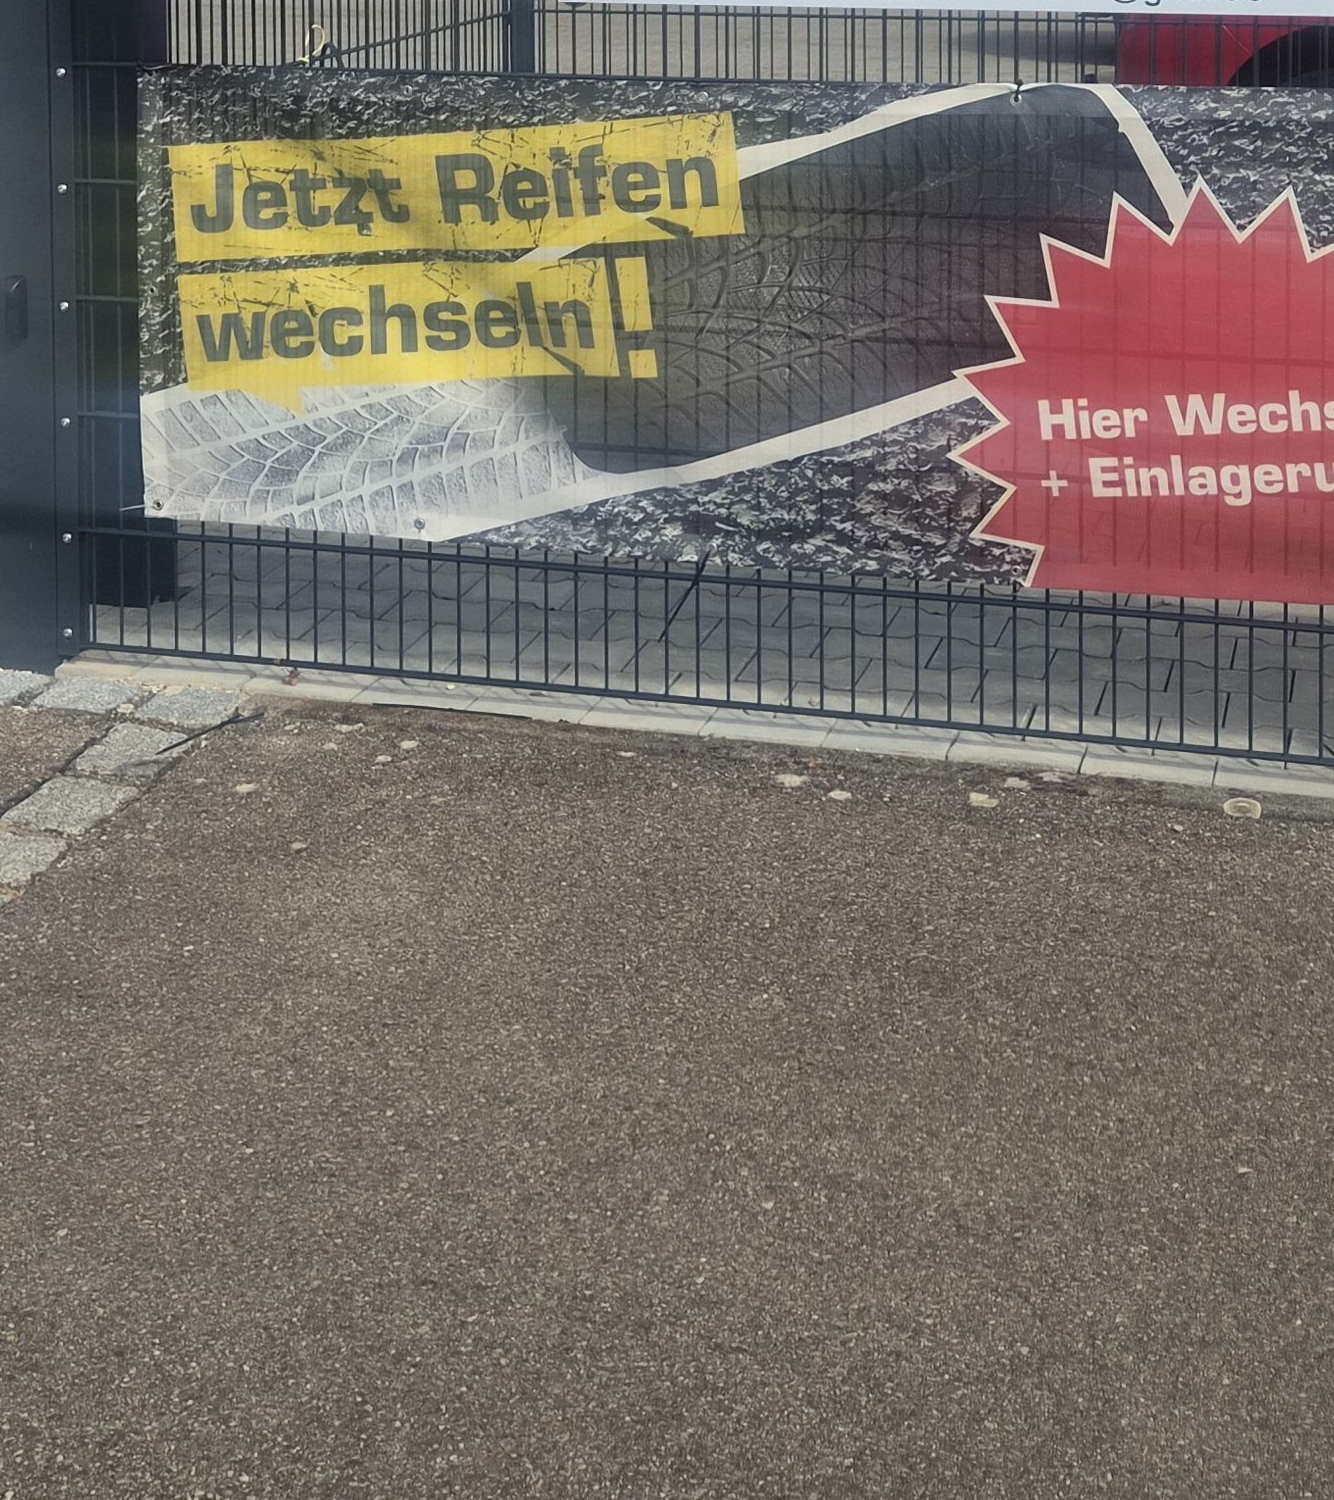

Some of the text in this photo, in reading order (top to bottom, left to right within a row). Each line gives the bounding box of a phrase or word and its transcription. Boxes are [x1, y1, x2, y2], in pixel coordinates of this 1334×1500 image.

[191, 144, 719, 233] Jetzt Reifen
[1038, 398, 1148, 440] Hier
[1041, 471, 1068, 496] +
